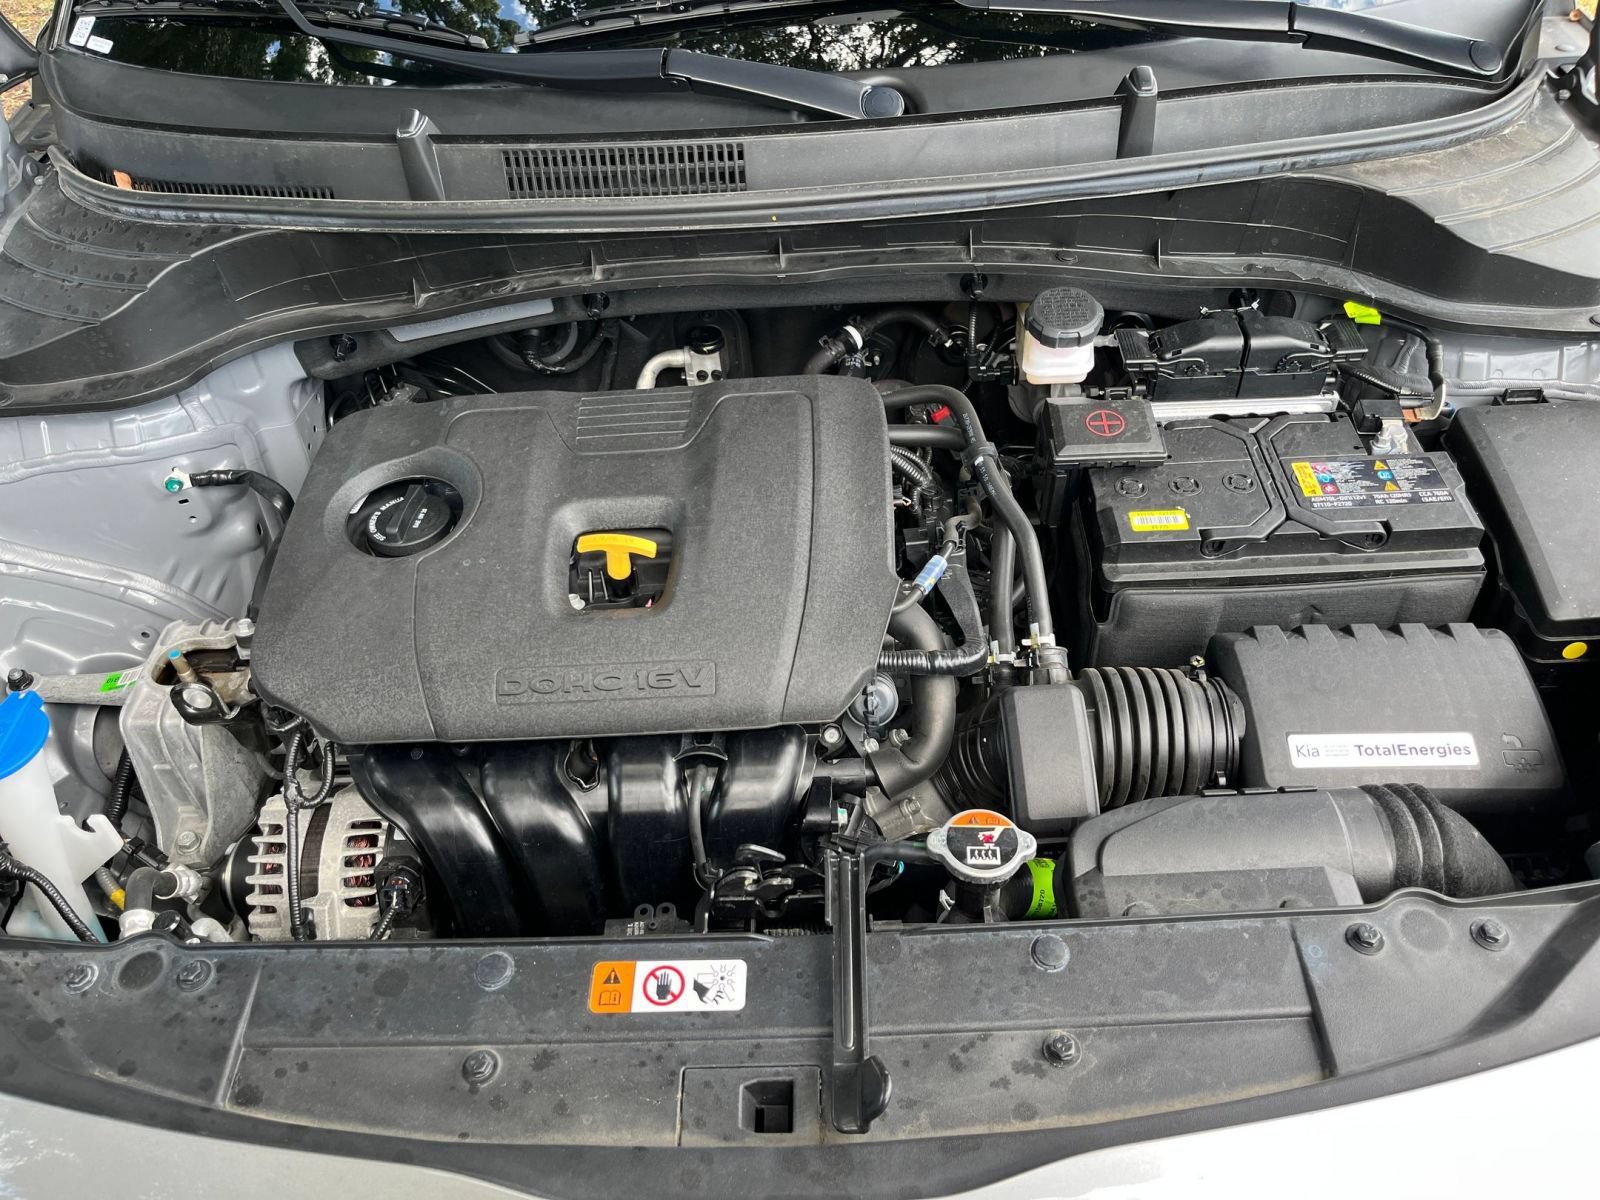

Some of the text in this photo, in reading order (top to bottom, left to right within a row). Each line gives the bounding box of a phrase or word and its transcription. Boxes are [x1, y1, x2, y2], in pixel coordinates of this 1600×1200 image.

[380, 496, 405, 511] MANUA
[498, 667, 704, 696] DOHC 16V
[1295, 744, 1320, 758] Kia
[1354, 743, 1472, 758] TotalEnergies
